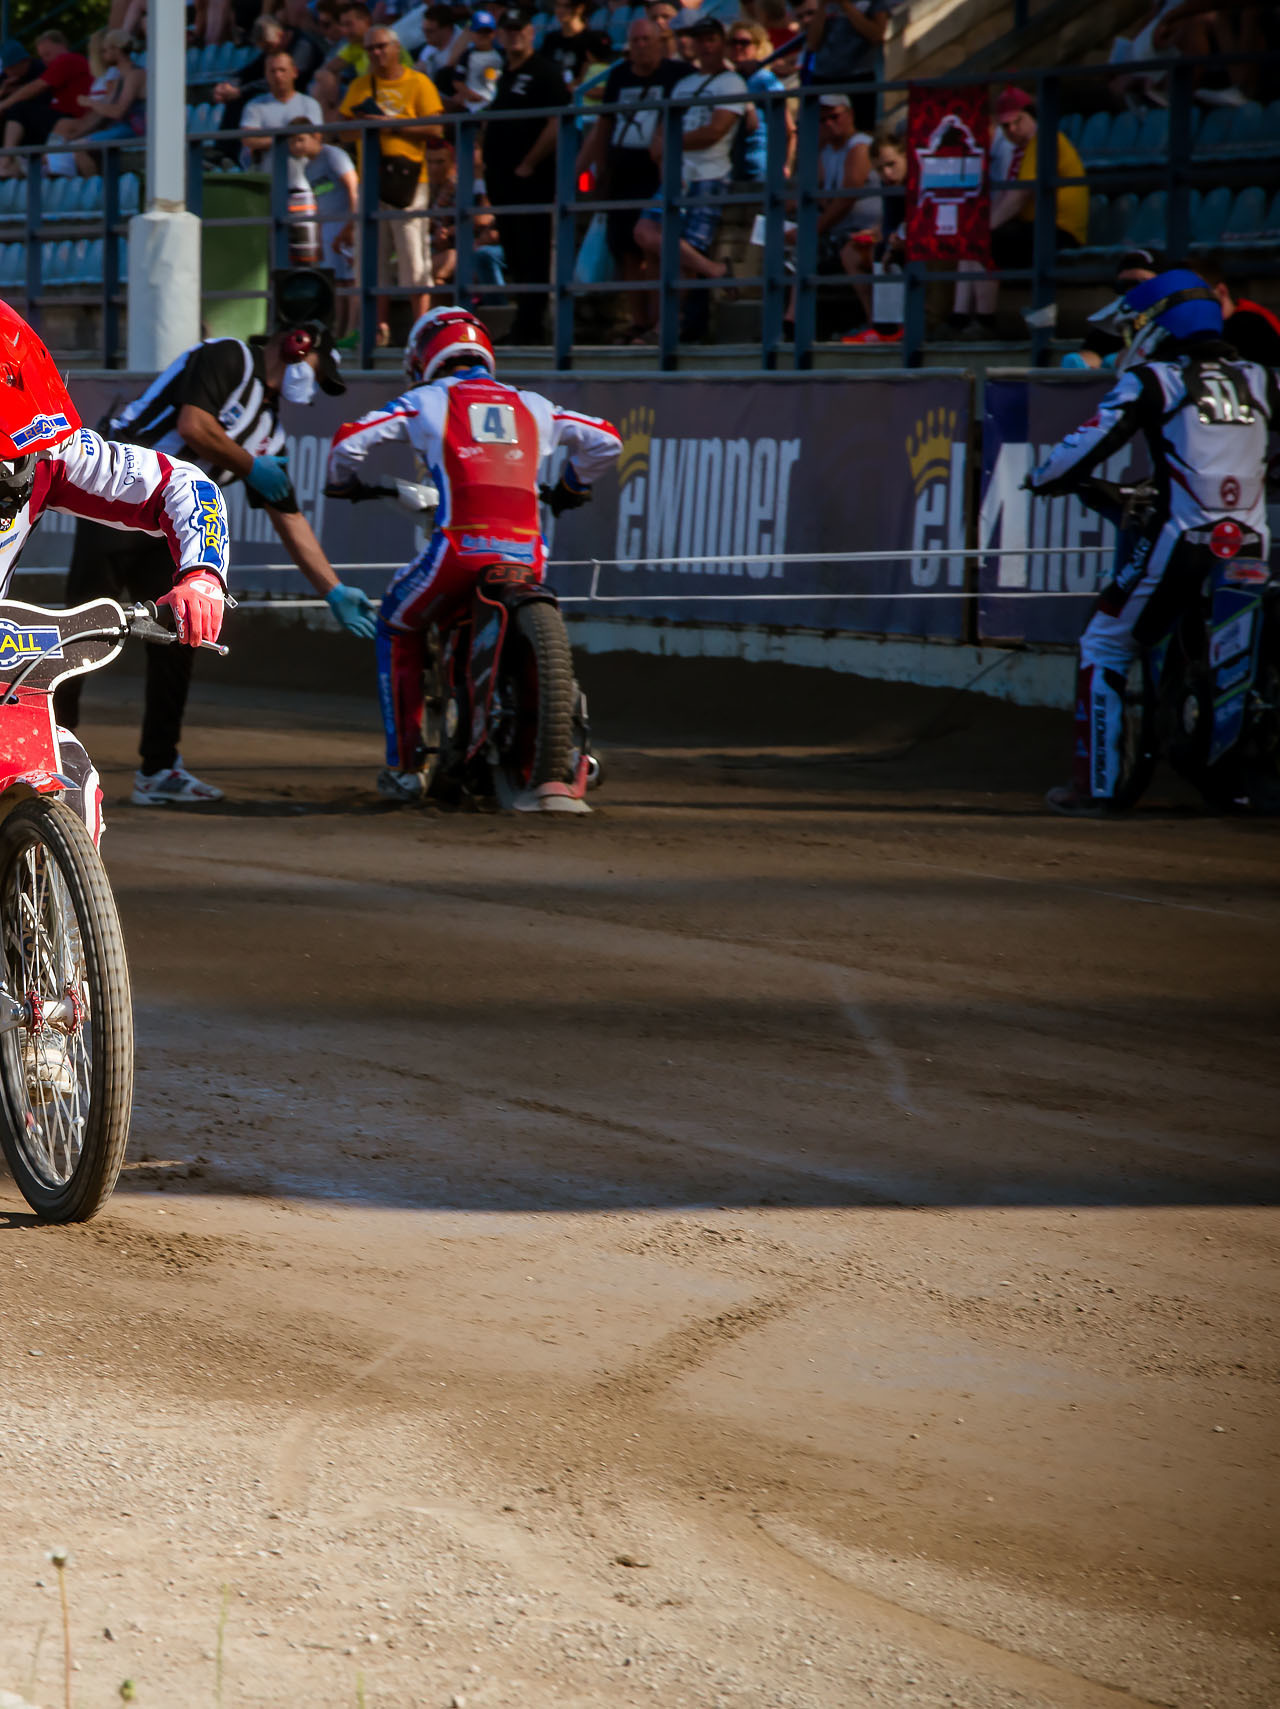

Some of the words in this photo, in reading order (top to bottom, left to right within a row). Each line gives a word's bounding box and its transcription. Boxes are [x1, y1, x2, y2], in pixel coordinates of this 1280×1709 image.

[24, 420, 60, 440] REALL
[483, 407, 504, 439] 4
[201, 498, 221, 554] REALL
